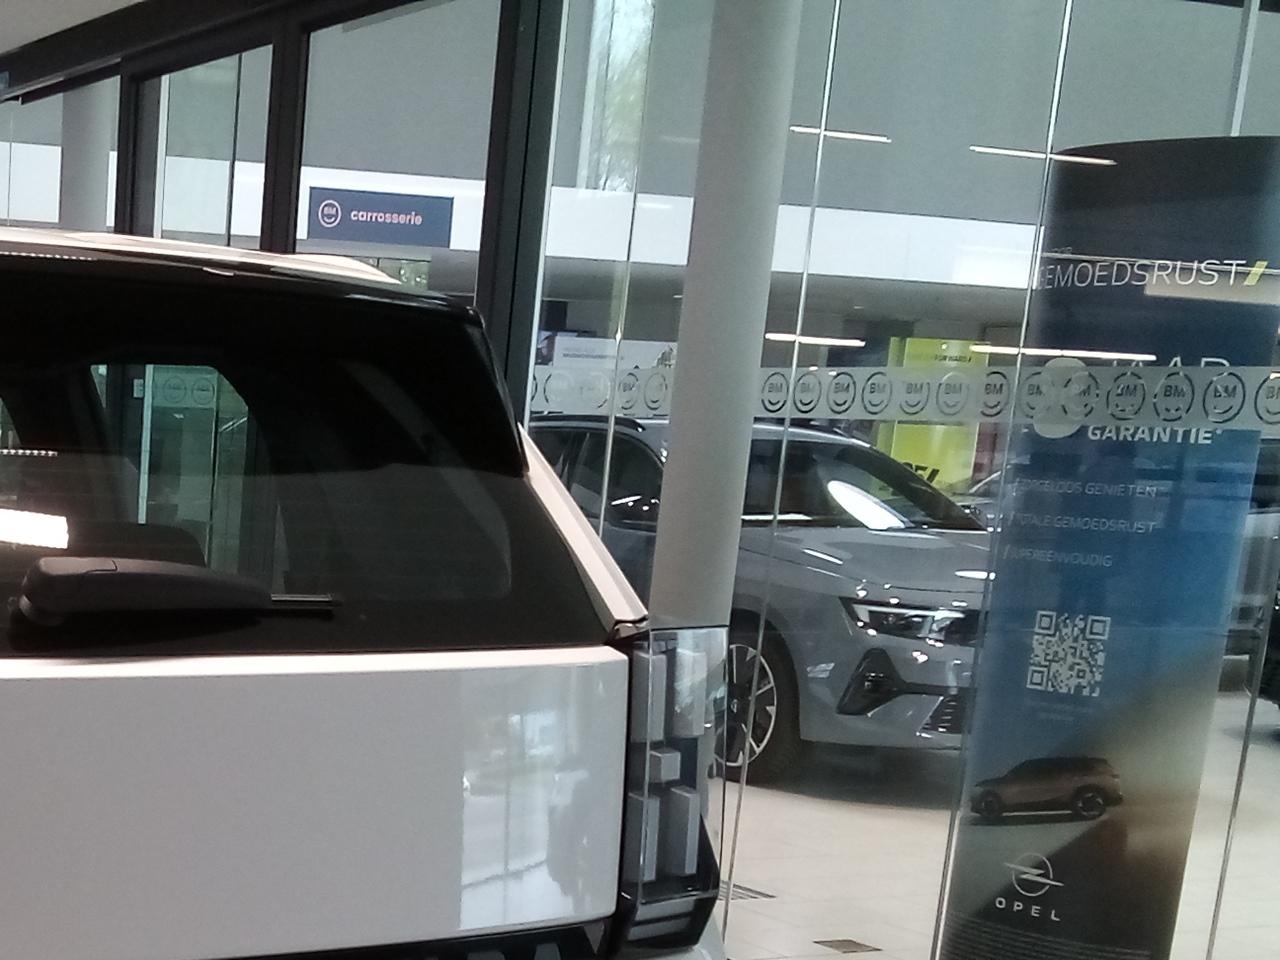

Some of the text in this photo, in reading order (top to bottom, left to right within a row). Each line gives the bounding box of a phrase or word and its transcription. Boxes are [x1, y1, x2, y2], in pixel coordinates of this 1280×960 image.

[350, 210, 422, 225] carrosserie
[834, 382, 850, 394] BM
[985, 382, 1003, 395] BM
[1164, 385, 1186, 397] BM
[995, 897, 1061, 921] OPEL
